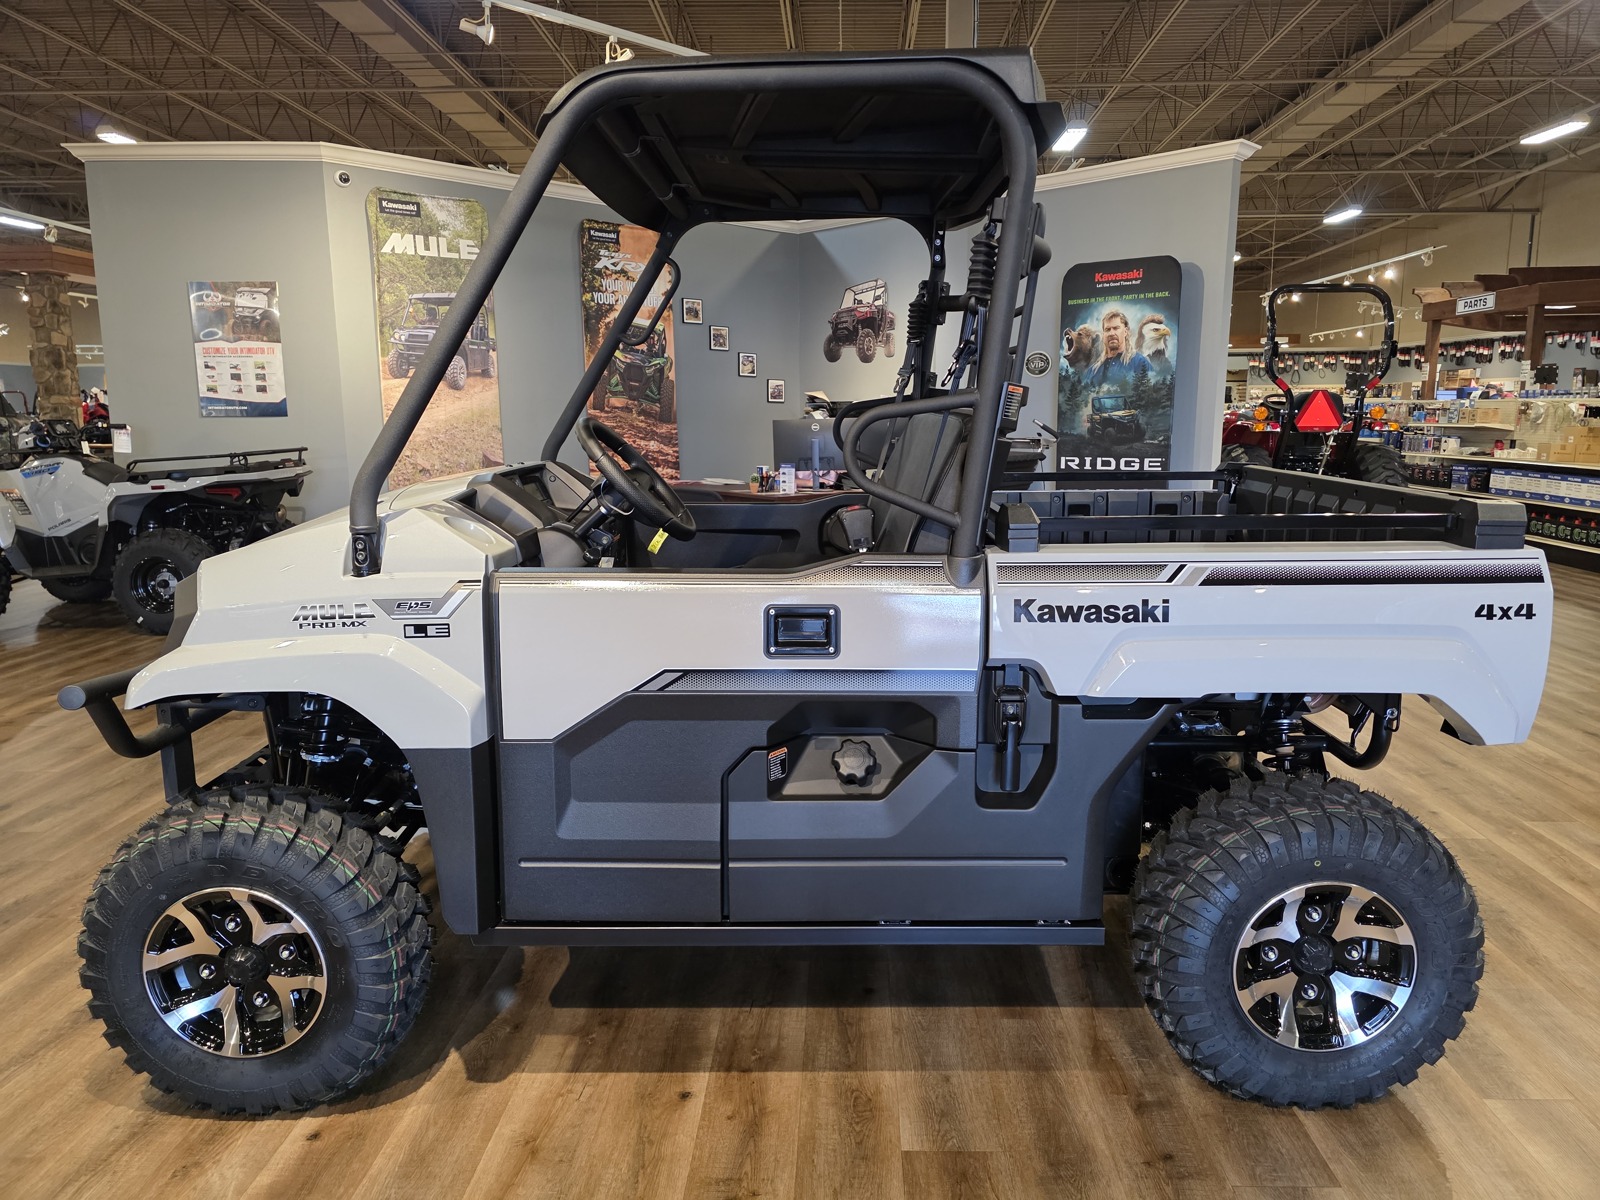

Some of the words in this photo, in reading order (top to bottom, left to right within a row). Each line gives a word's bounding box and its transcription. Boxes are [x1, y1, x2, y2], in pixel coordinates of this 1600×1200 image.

[382, 200, 417, 211] Kawasaki
[590, 229, 617, 239] Kawasaki
[381, 233, 480, 260] MULE
[1095, 269, 1143, 282] Kawasaki
[601, 279, 624, 291] YOUR
[593, 292, 616, 305] YOUR
[1067, 298, 1090, 306] BUSINESS
[1463, 298, 1488, 310] PARTS
[202, 347, 226, 355] CUSTOMIZE
[227, 347, 239, 355] YOUR
[239, 347, 265, 355] INTIMIDATOR
[1030, 361, 1045, 369] VIP
[1060, 456, 1163, 471] RIDGE
[47, 518, 72, 531] POLARIS
[395, 601, 432, 611] EPS
[1013, 598, 1170, 624] Kawasaki
[1474, 603, 1536, 620] 4x4
[292, 603, 376, 622] MULE
[298, 620, 368, 630] PRO-MX
[405, 625, 449, 637] LE
